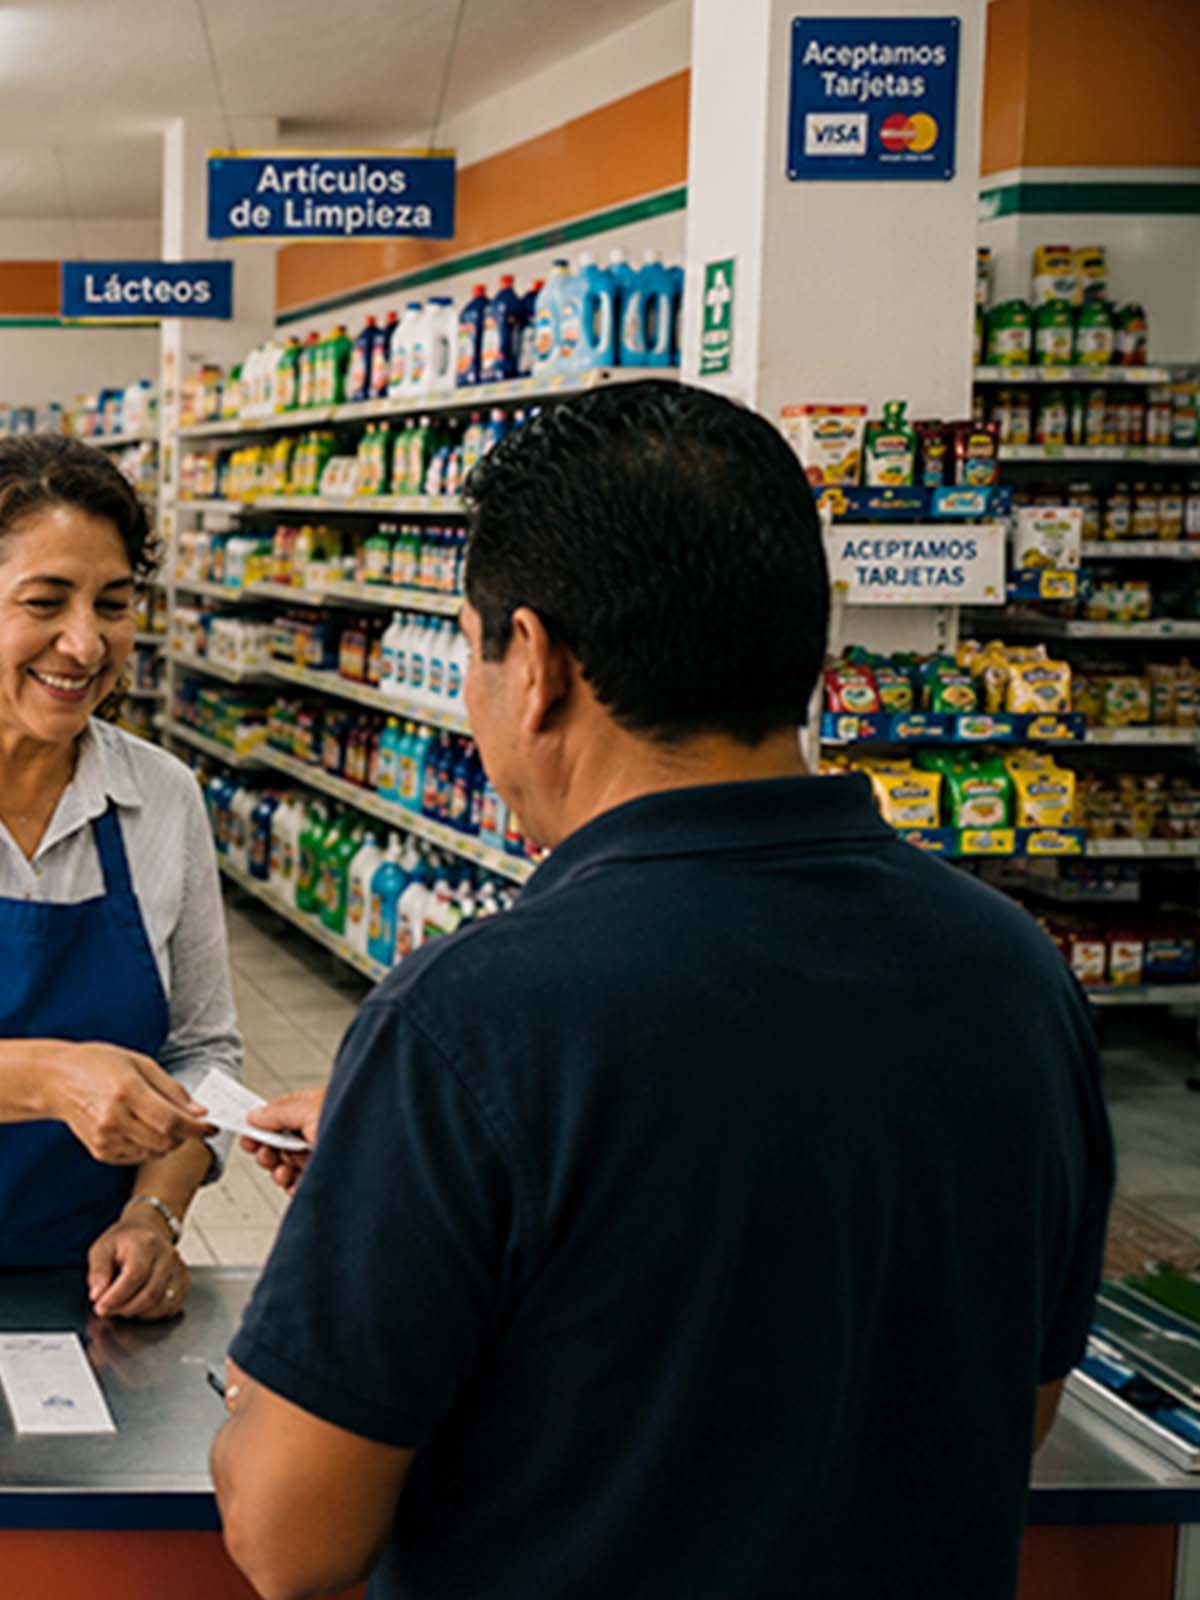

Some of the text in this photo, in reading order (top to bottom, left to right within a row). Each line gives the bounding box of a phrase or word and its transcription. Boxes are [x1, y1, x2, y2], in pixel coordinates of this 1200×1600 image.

[802, 40, 947, 71] Aceptamos
[821, 71, 926, 102] Tarjetas
[813, 124, 860, 143] VISA
[256, 163, 406, 194] Artículos
[229, 200, 432, 234] de Limpieza
[84, 274, 211, 303] Lácteos
[841, 539, 978, 560] ACEPTAMOS
[856, 566, 965, 586] TARJETAS
